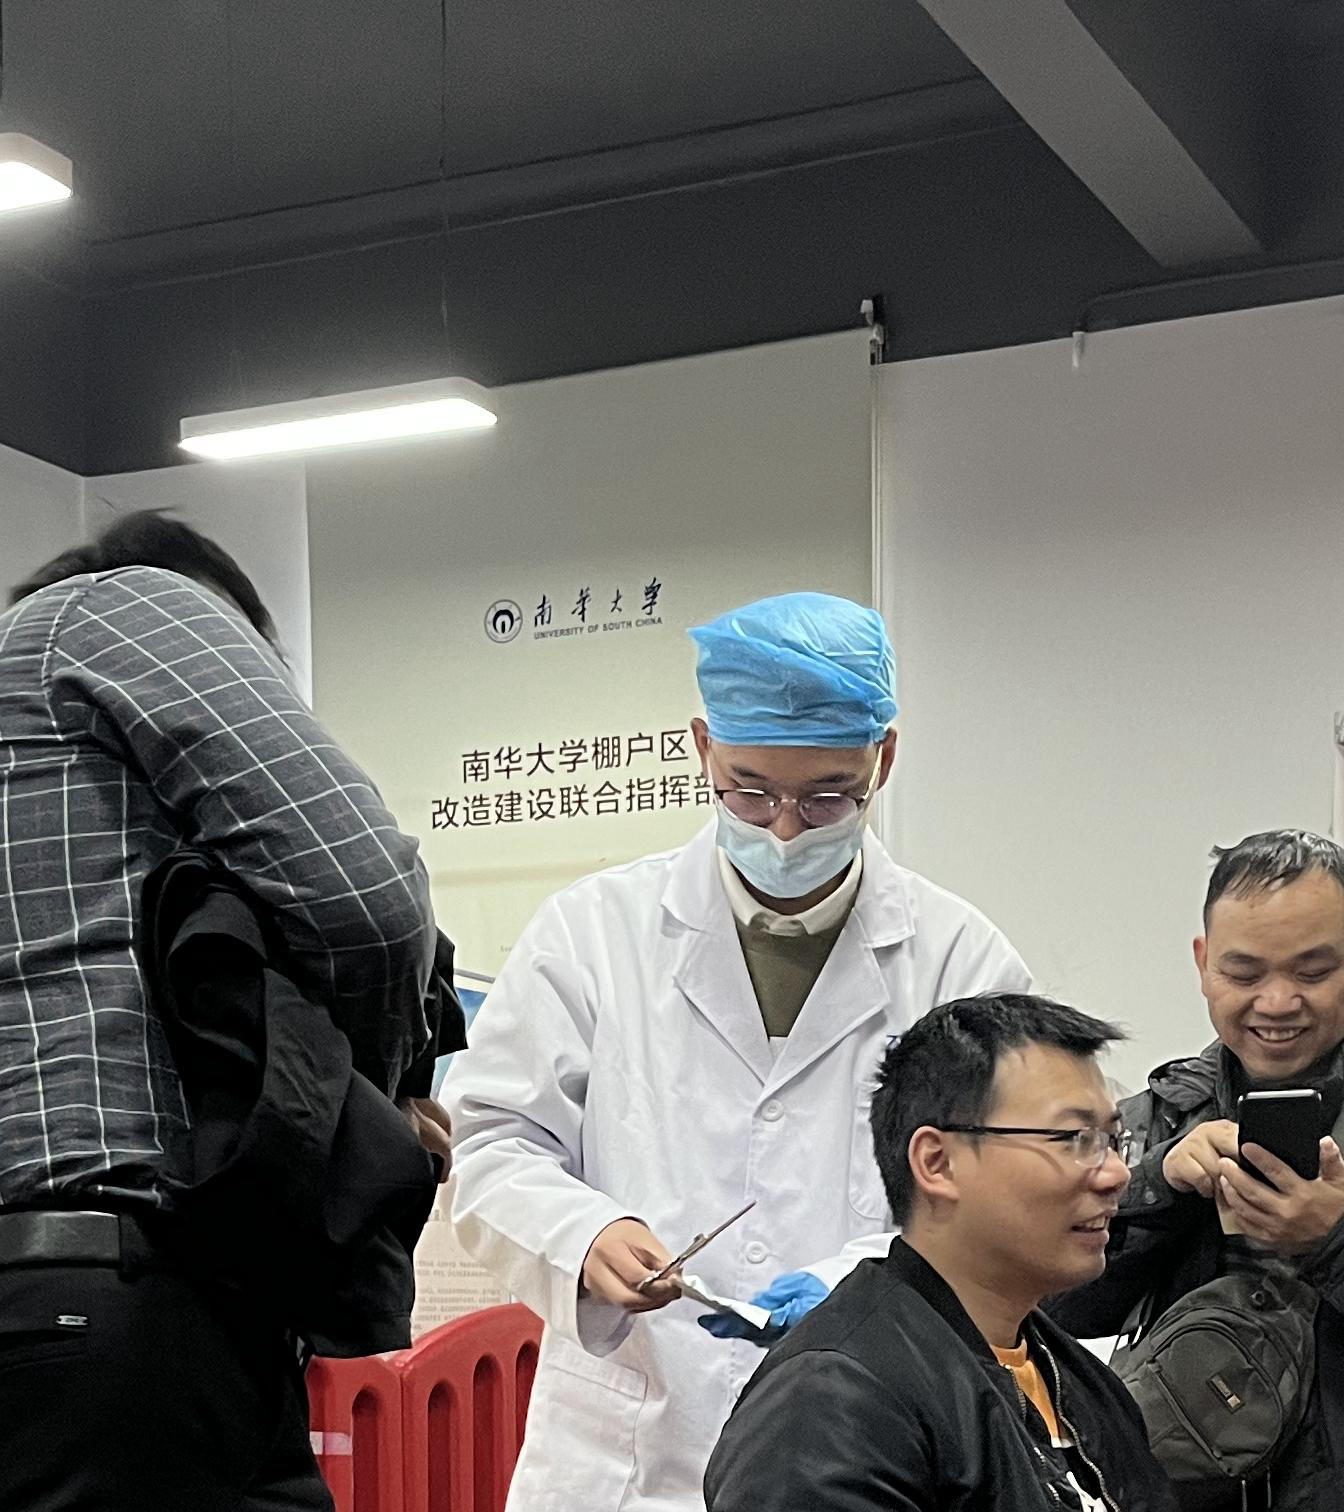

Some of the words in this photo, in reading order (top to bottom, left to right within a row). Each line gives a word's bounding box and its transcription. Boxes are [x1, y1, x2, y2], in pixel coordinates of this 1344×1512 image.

[533, 625, 584, 641] UNIVERSITY
[588, 624, 599, 634] OF
[602, 620, 633, 632] SOUTH
[635, 616, 664, 628] CHINA
[461, 729, 690, 784] 南华大学棚户区
